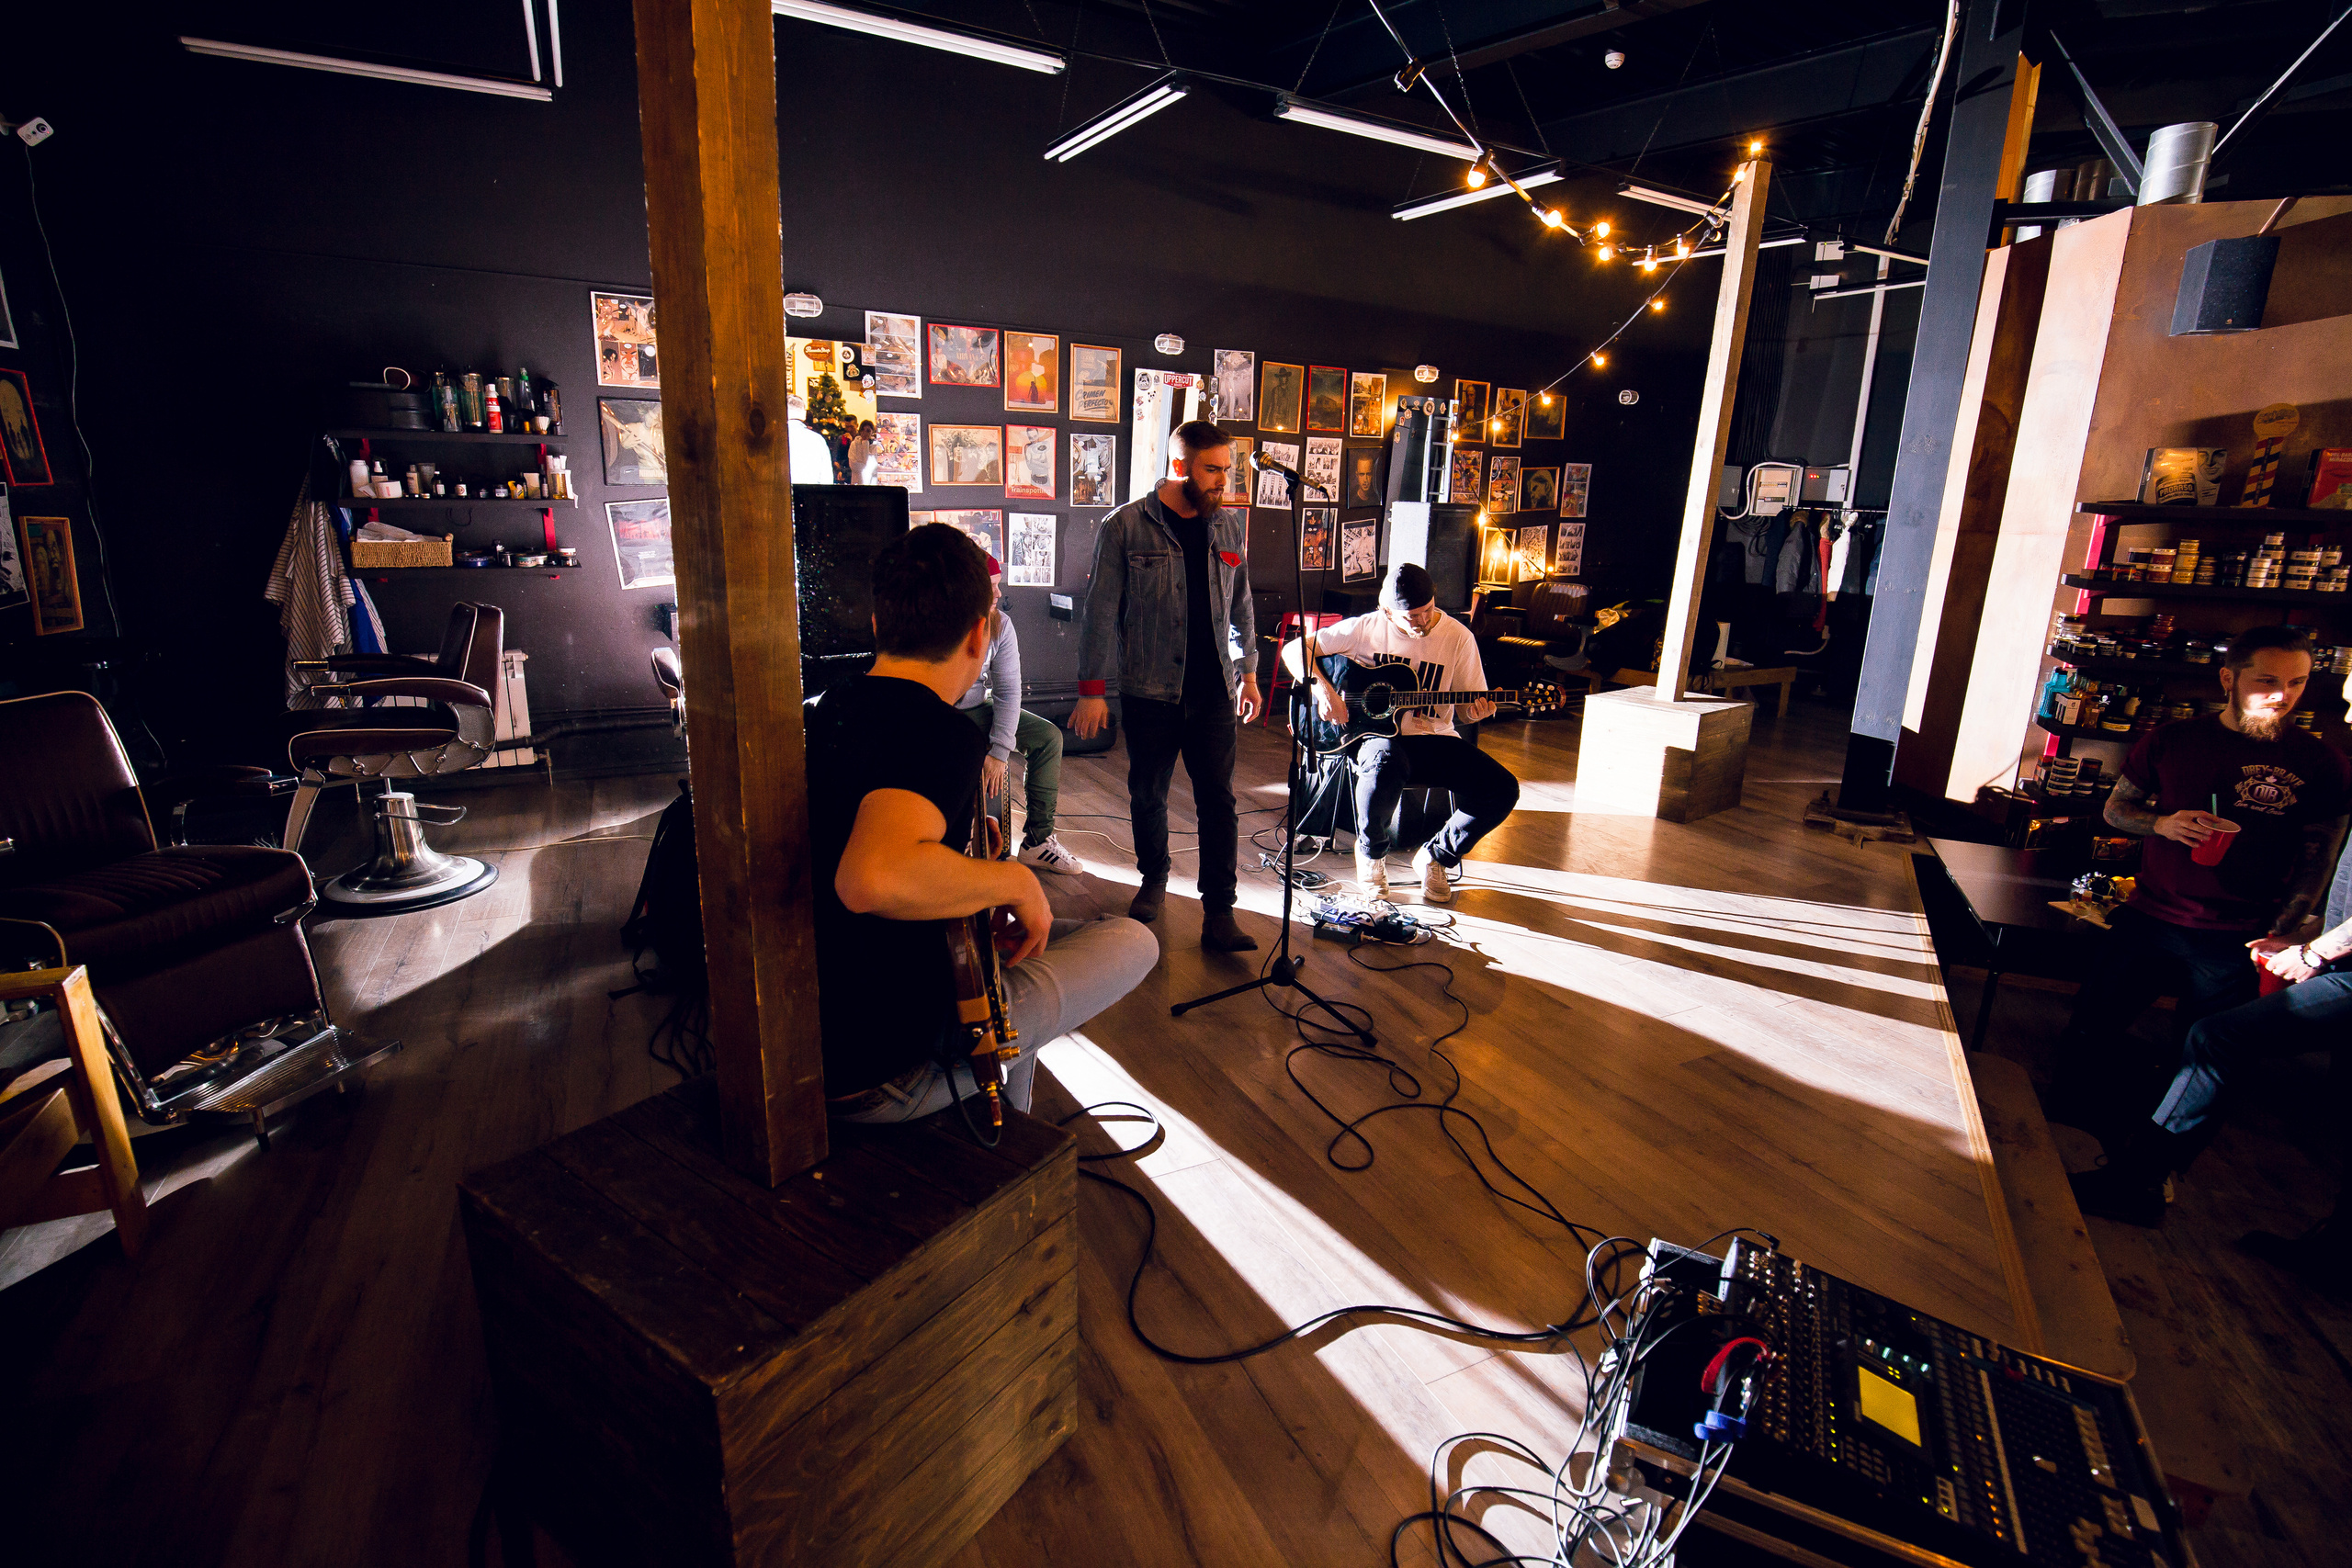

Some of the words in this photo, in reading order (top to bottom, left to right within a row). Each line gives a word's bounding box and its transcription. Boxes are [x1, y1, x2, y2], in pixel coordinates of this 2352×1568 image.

[1164, 374, 1193, 386] UPPERCUT
[1075, 389, 1106, 401] CRIMEN
[1077, 399, 1110, 411] PERFECTO
[1011, 486, 1051, 494] Trainspotting
[2159, 483, 2193, 497] PRORASO
[2241, 765, 2269, 776] OBEY
[2273, 767, 2305, 787] BRAVE
[2254, 784, 2278, 803] OTB
